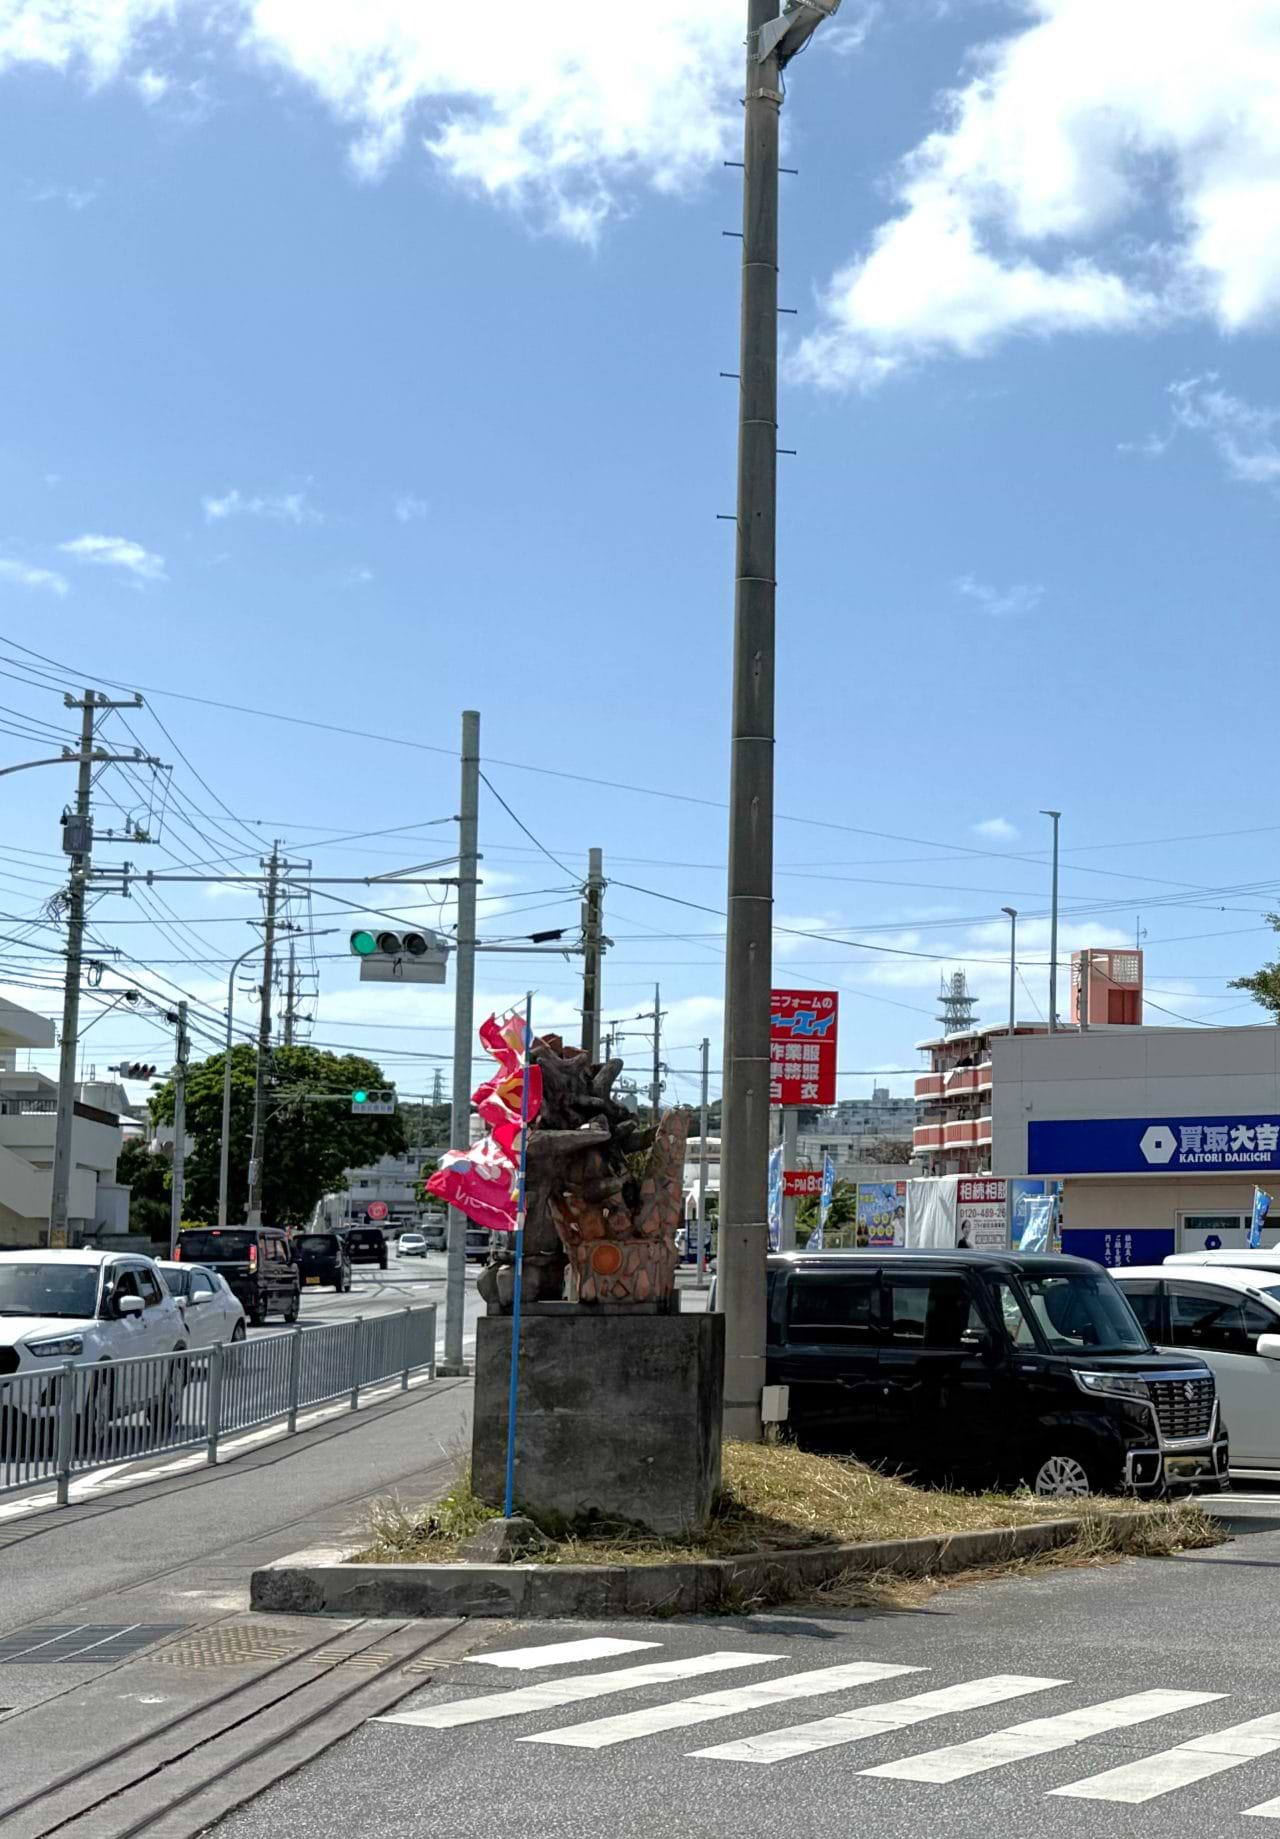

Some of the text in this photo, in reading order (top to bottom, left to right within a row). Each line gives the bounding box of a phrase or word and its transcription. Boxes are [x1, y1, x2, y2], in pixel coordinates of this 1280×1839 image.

[770, 1043, 820, 1061] 作業服
[1178, 1123, 1280, 1153] 買取大吉
[1179, 1152, 1271, 1163] KAITORI DAIKICHI
